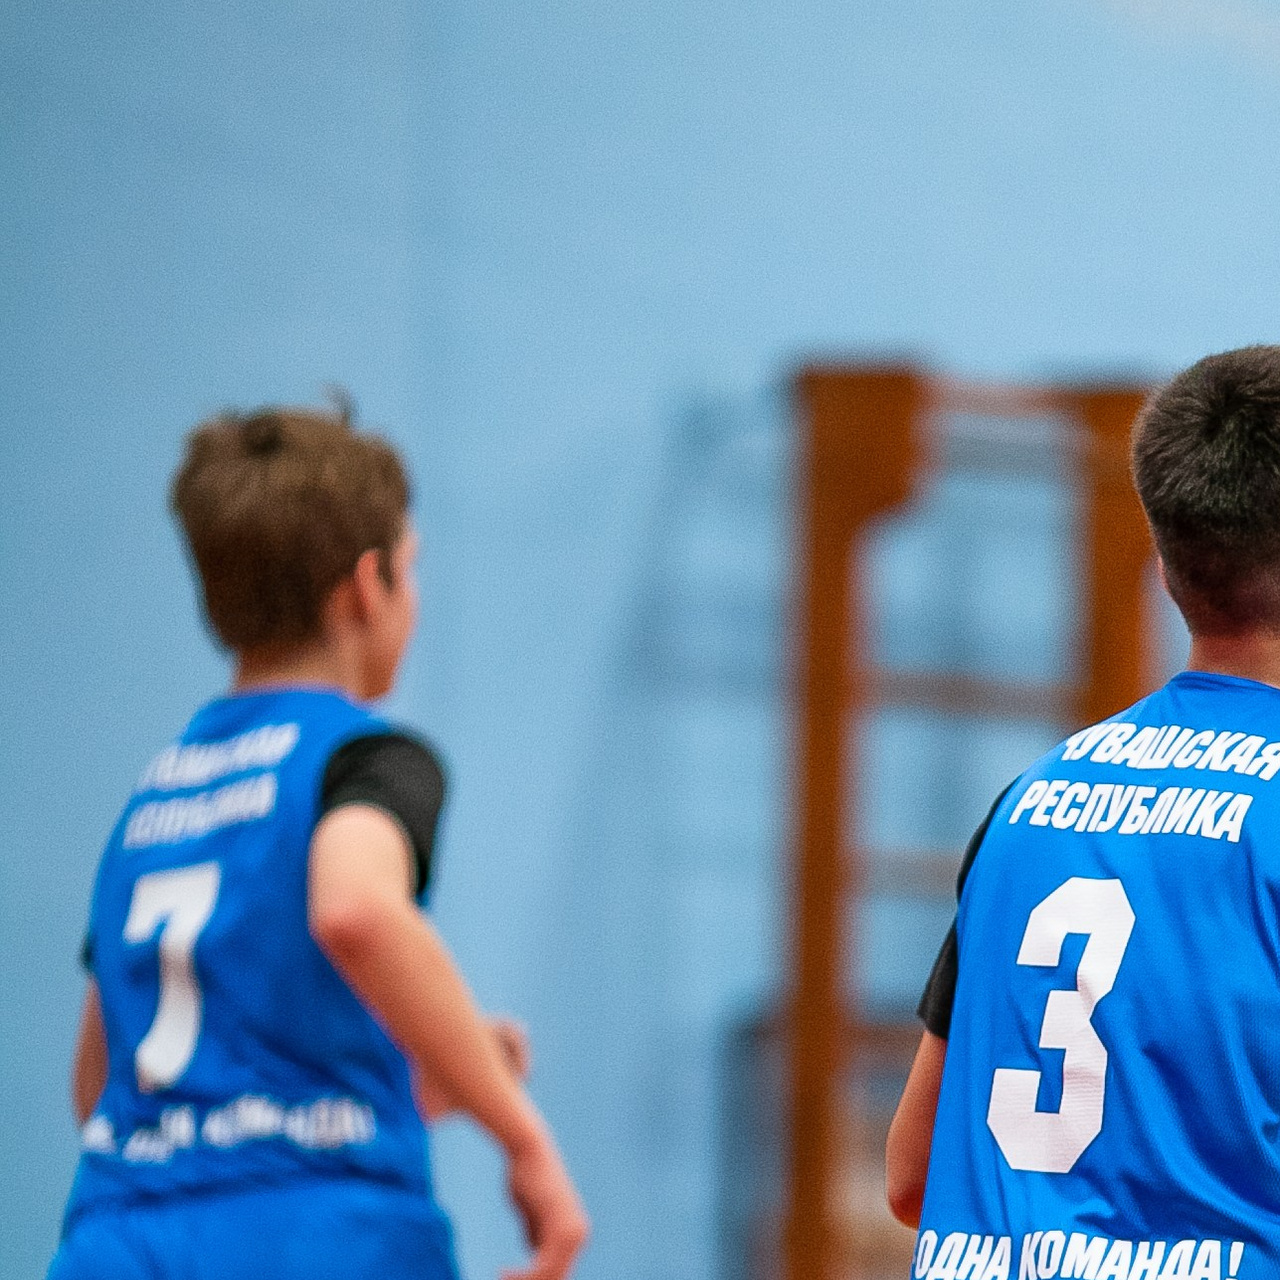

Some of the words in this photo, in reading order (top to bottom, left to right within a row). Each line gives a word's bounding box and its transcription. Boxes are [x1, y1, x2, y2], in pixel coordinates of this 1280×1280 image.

[1008, 780, 1254, 843] РЕСПУБЛИКА
[123, 862, 222, 1092] 7
[988, 877, 1135, 1174] 3
